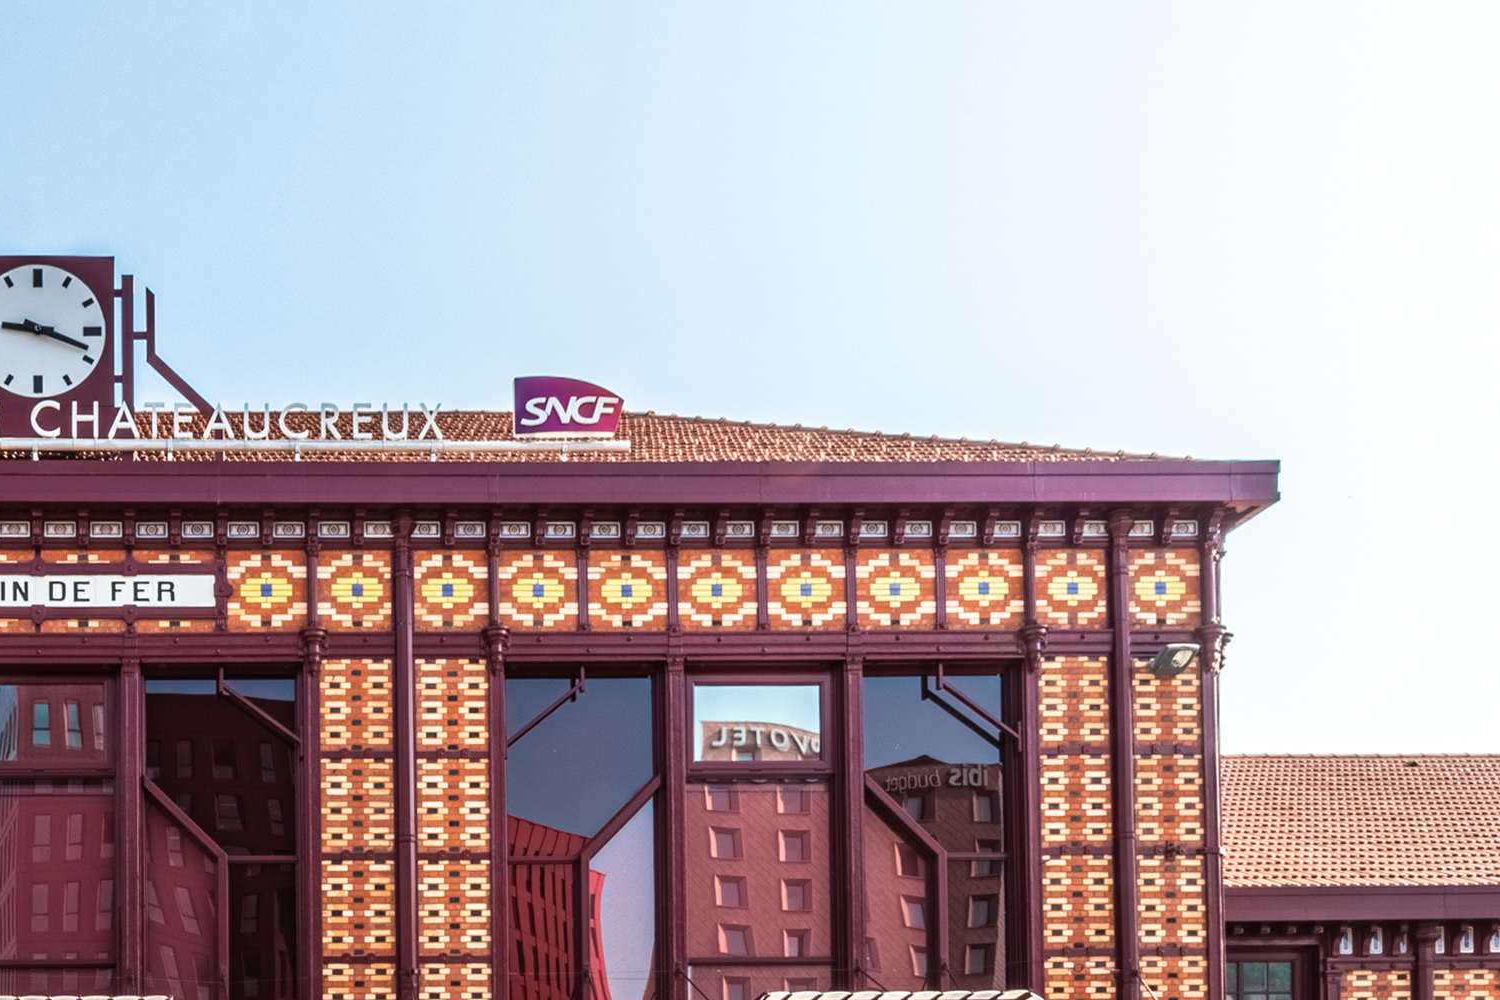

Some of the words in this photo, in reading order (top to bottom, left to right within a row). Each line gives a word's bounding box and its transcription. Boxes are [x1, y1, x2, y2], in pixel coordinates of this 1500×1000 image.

[519, 394, 620, 427] SNCF
[48, 578, 91, 604] DE
[111, 578, 177, 603] FER
